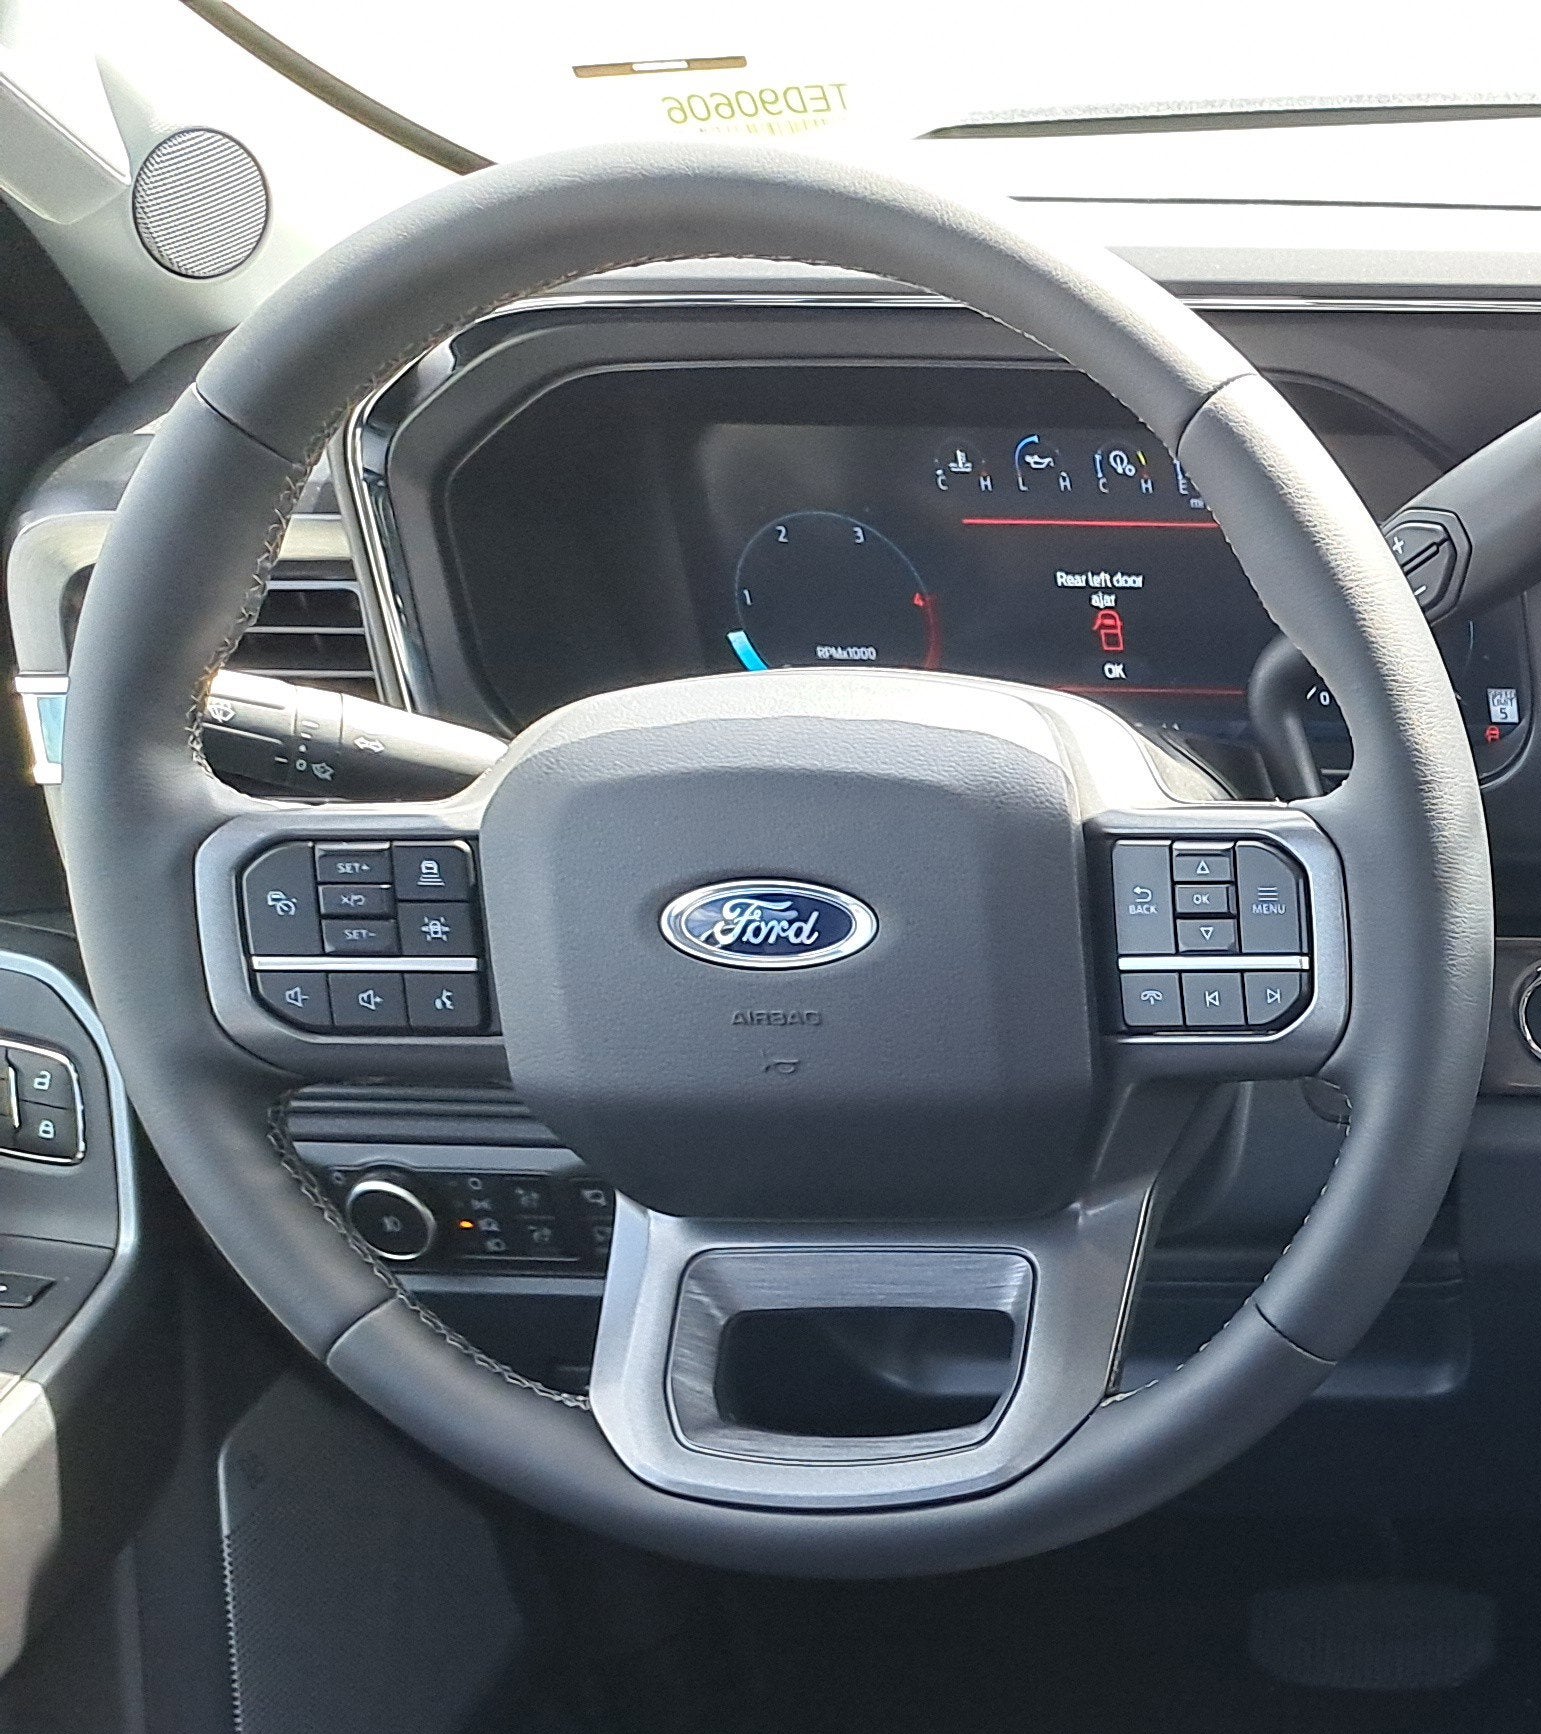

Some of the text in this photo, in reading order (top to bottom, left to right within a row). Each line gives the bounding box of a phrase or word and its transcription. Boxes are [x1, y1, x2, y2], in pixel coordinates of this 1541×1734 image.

[937, 476, 948, 491] C
[980, 476, 992, 491] H
[1018, 476, 1028, 491] L
[1141, 479, 1153, 493] H
[776, 526, 788, 543] 2
[853, 527, 865, 543] 3
[1056, 571, 1143, 588] Rear left door
[743, 589, 752, 605] 1
[1104, 663, 1126, 678] OK
[1500, 707, 1508, 720] 5
[1193, 894, 1210, 905] OK
[1129, 904, 1157, 915] BACK
[1253, 904, 1286, 915] MENU
[700, 898, 819, 948] Ford
[732, 1010, 822, 1026] AIRBAG
